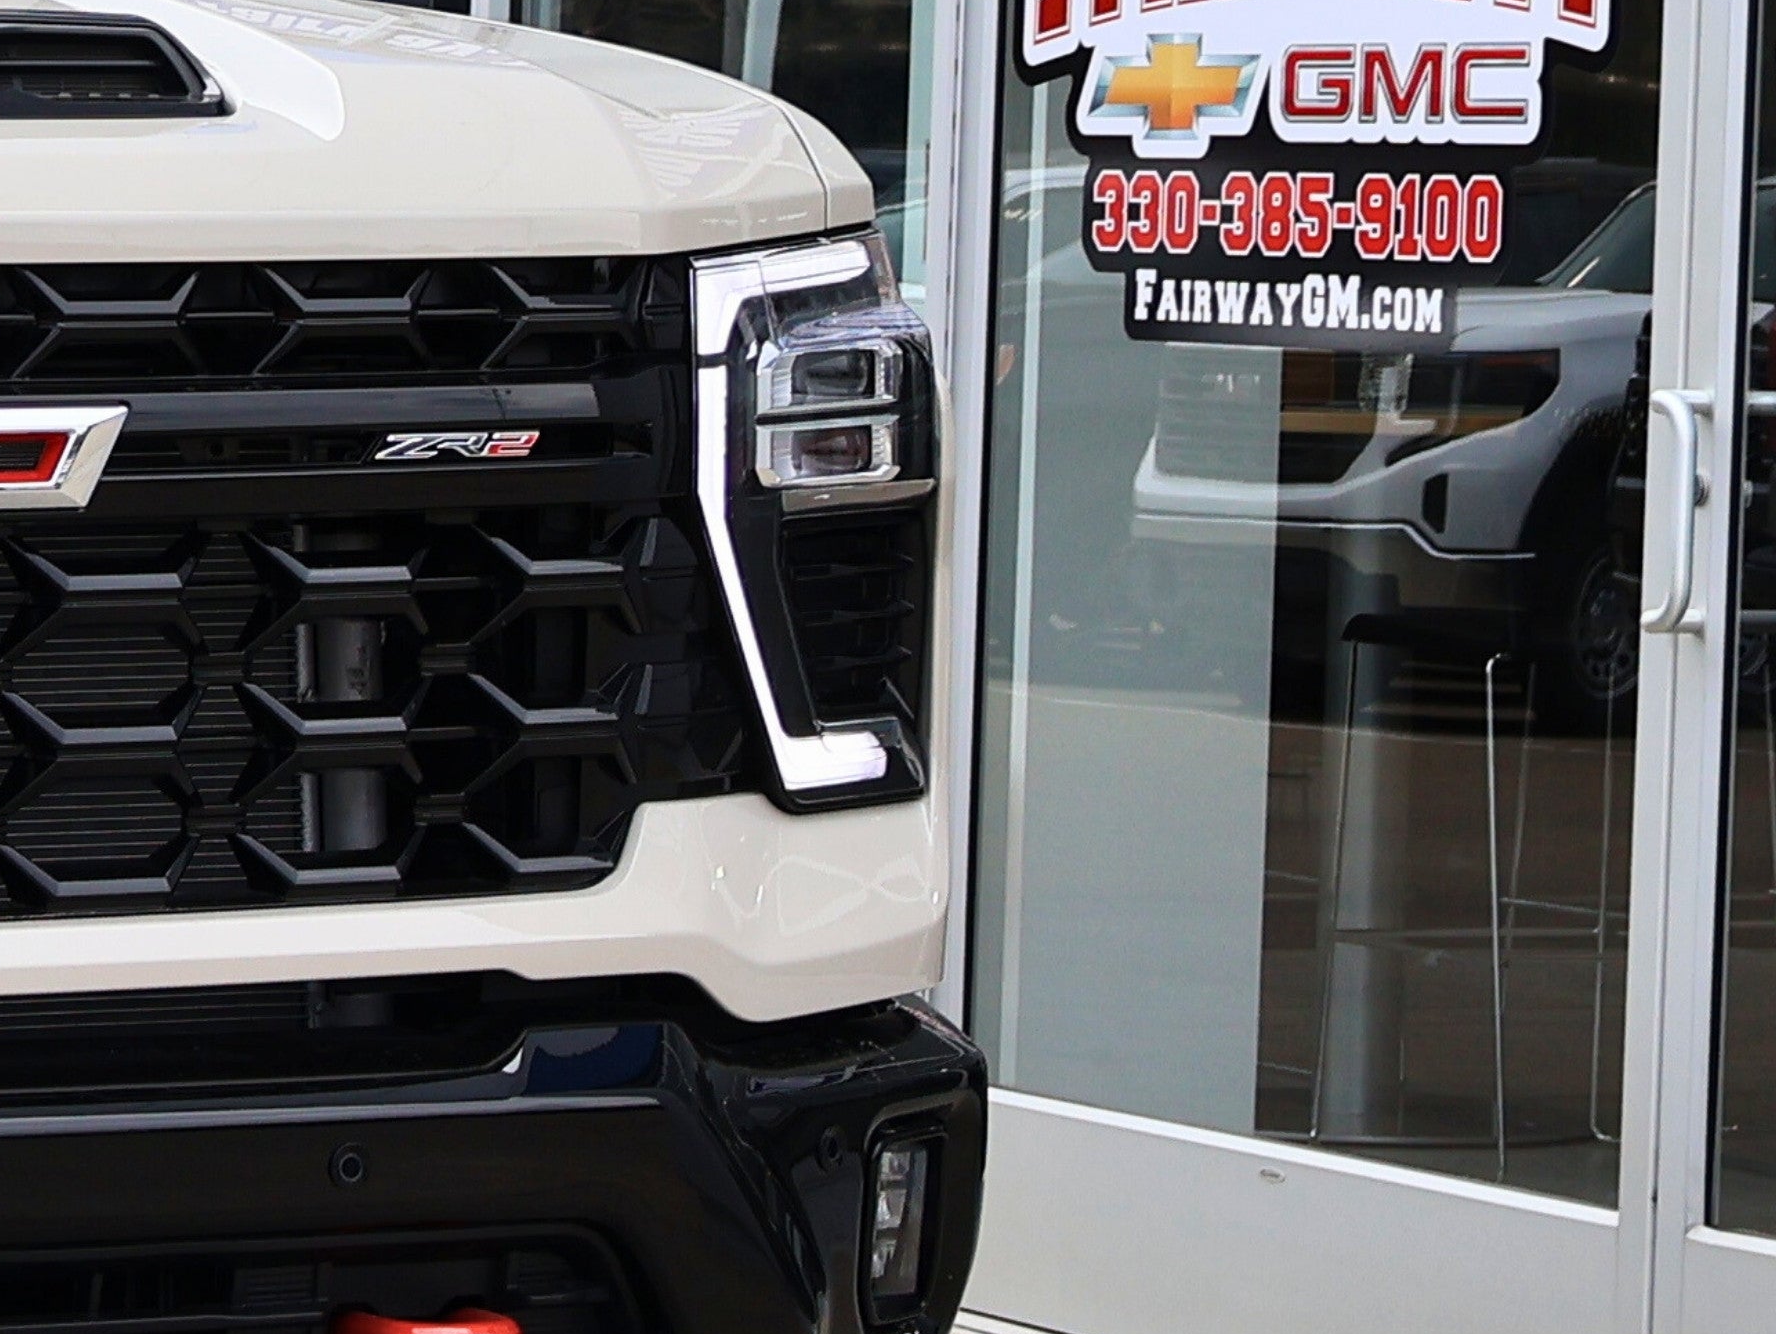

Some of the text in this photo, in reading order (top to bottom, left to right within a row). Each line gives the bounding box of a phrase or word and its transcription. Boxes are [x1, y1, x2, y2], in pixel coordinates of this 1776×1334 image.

[1280, 43, 1532, 124] GMC
[1091, 169, 1503, 263] 330-385-9100
[374, 431, 540, 461] ZR2
